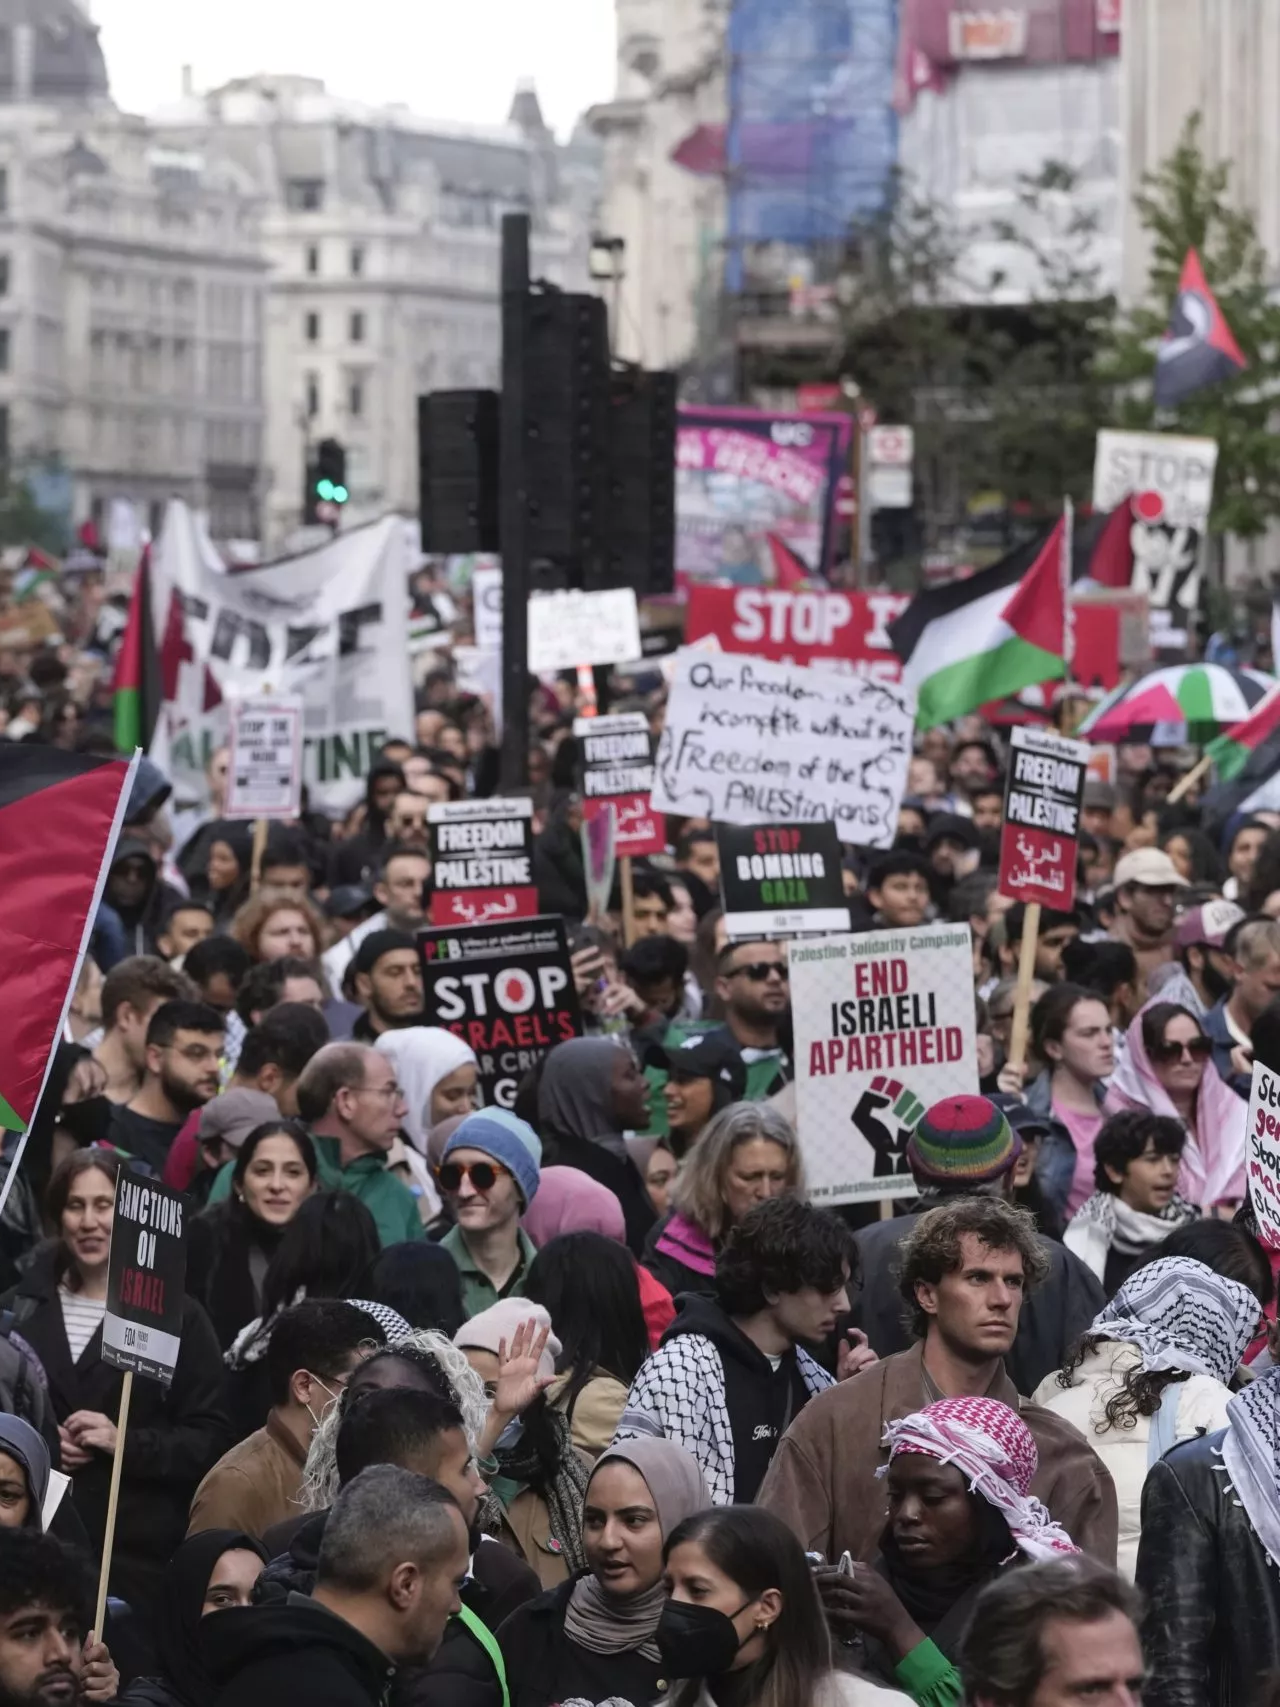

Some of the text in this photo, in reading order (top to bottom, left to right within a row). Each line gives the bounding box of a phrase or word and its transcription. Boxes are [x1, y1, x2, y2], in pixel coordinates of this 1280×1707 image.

[1109, 447, 1210, 488] STOP
[732, 590, 852, 646] STOP
[689, 662, 734, 688] Our
[811, 713, 872, 739] without
[798, 756, 820, 780] of
[1015, 752, 1080, 794] FREEDOM
[1008, 791, 1078, 836] PALESTINE
[437, 820, 525, 852] FREEDOM
[754, 829, 801, 854] STOP
[434, 857, 532, 889] PALESTINE
[736, 852, 825, 881] BOMBING
[760, 880, 809, 904] GAZA
[424, 938, 462, 964] PFB
[791, 932, 968, 963] Palestine Solidarity Campaign
[434, 965, 568, 1020] STOP
[854, 959, 908, 998] END
[440, 1012, 576, 1051] SRAEL'S
[831, 992, 936, 1037] ISRAELI
[809, 1026, 963, 1077] APARTHEID
[119, 1179, 183, 1239] SANCTIONS
[136, 1230, 157, 1270] ON
[120, 1267, 166, 1315] ISRAEL
[124, 1327, 136, 1347] FOA
